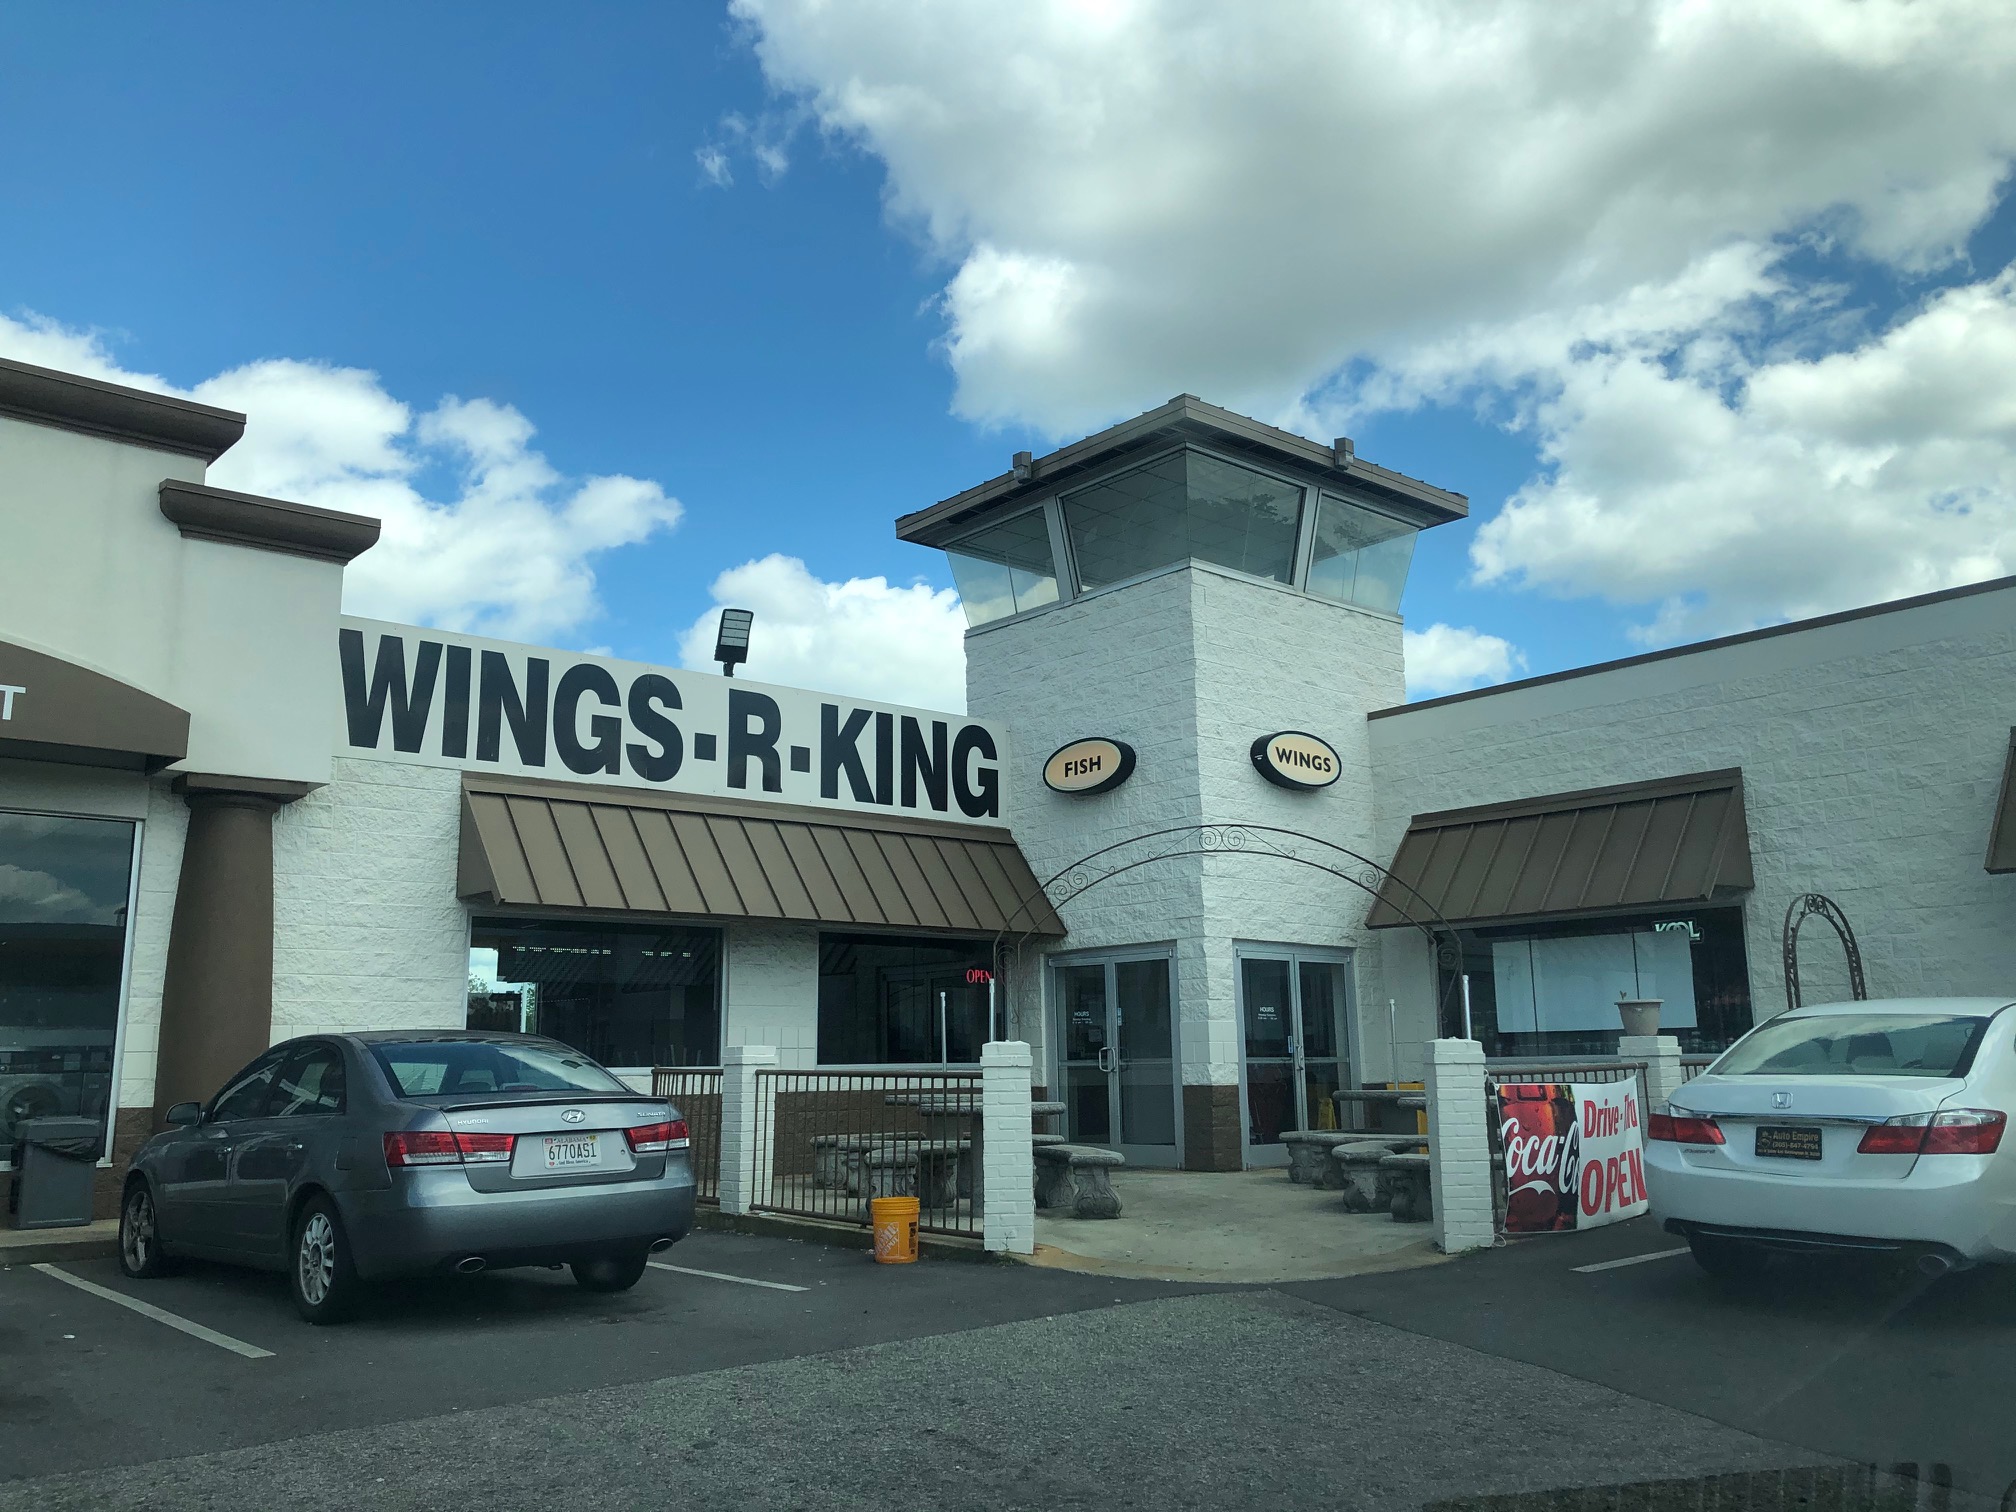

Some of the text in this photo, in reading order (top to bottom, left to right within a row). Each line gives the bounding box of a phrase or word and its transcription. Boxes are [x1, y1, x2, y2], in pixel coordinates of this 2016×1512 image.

[339, 629, 999, 819] WINGS-R-KING
[1064, 755, 1102, 779] FISH
[1275, 746, 1332, 774] WINGS
[966, 969, 992, 984] OPEN
[1772, 1131, 1819, 1143] Auto Empire
[549, 1142, 597, 1161] 6770AS1
[1581, 1148, 1648, 1217] OPEN
